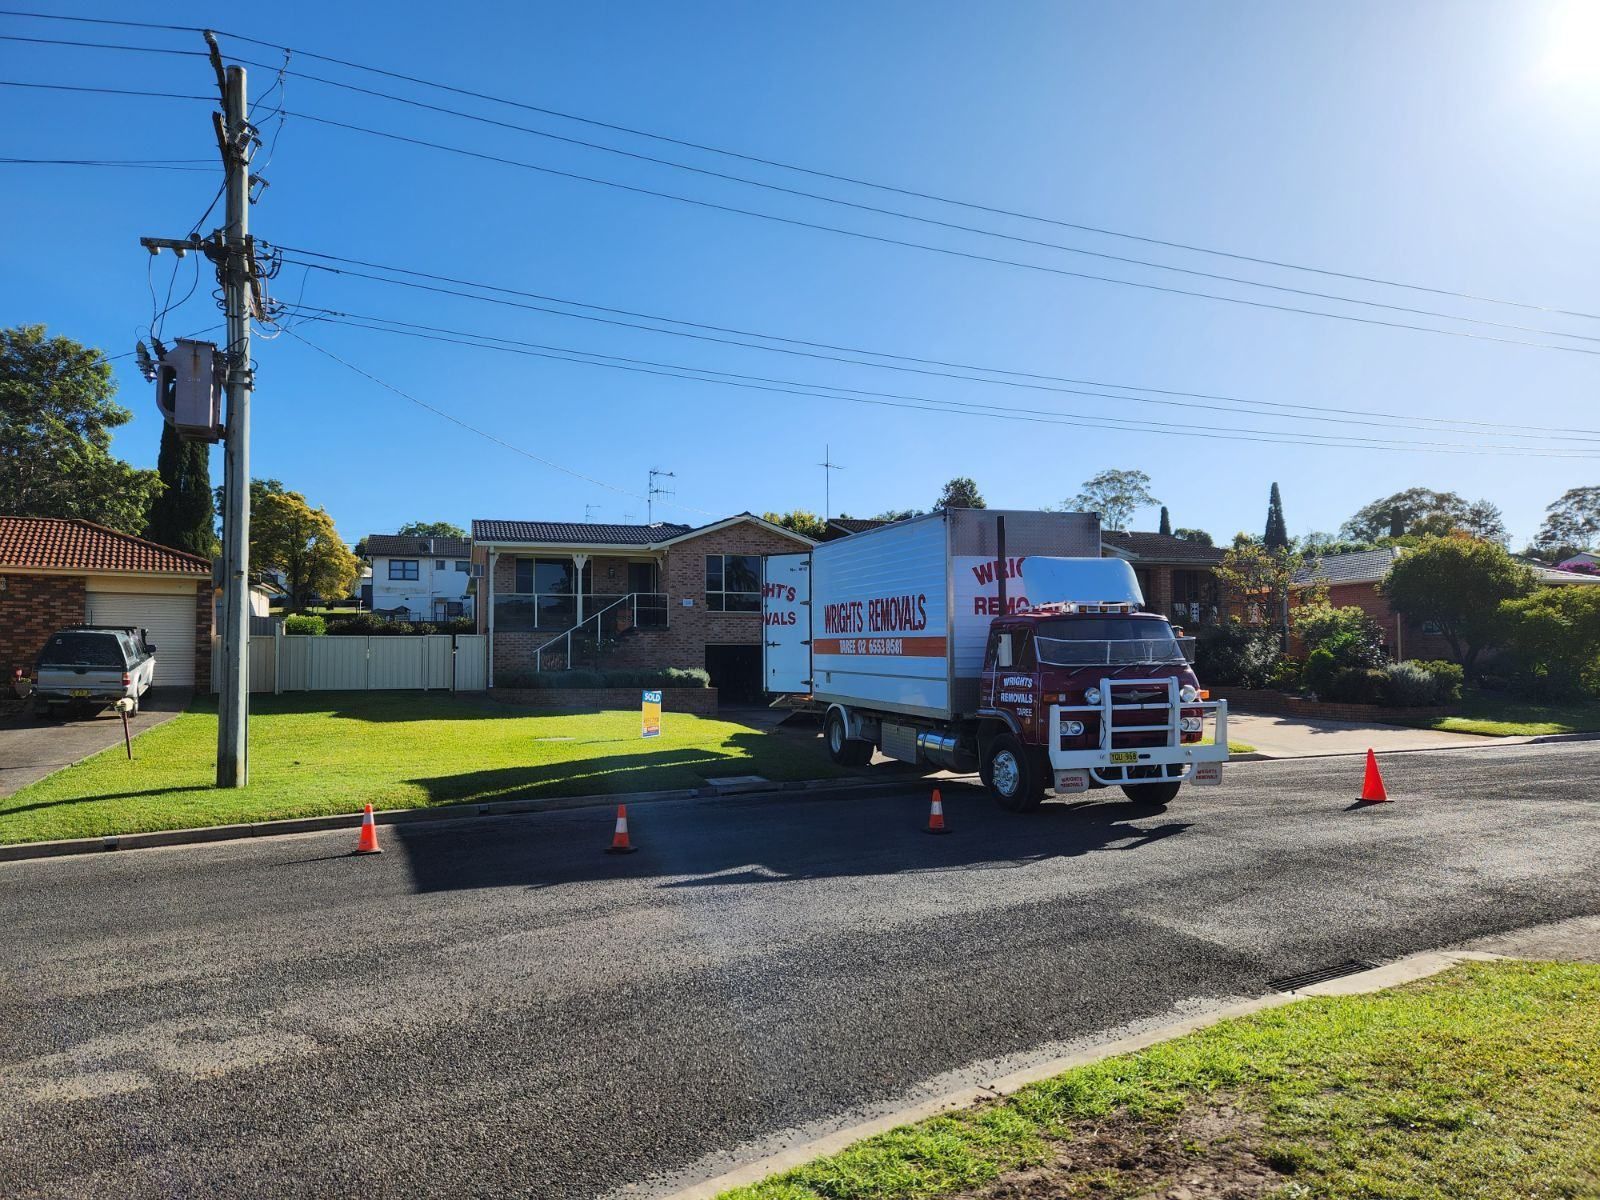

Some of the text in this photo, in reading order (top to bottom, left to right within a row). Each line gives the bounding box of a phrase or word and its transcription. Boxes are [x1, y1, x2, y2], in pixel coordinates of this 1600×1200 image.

[869, 593, 927, 632] REMOVALS
[857, 639, 867, 654] 02
[645, 692, 660, 702] SOLD
[1000, 692, 1033, 704] REMOVALS
[1016, 707, 1033, 717] TAREE
